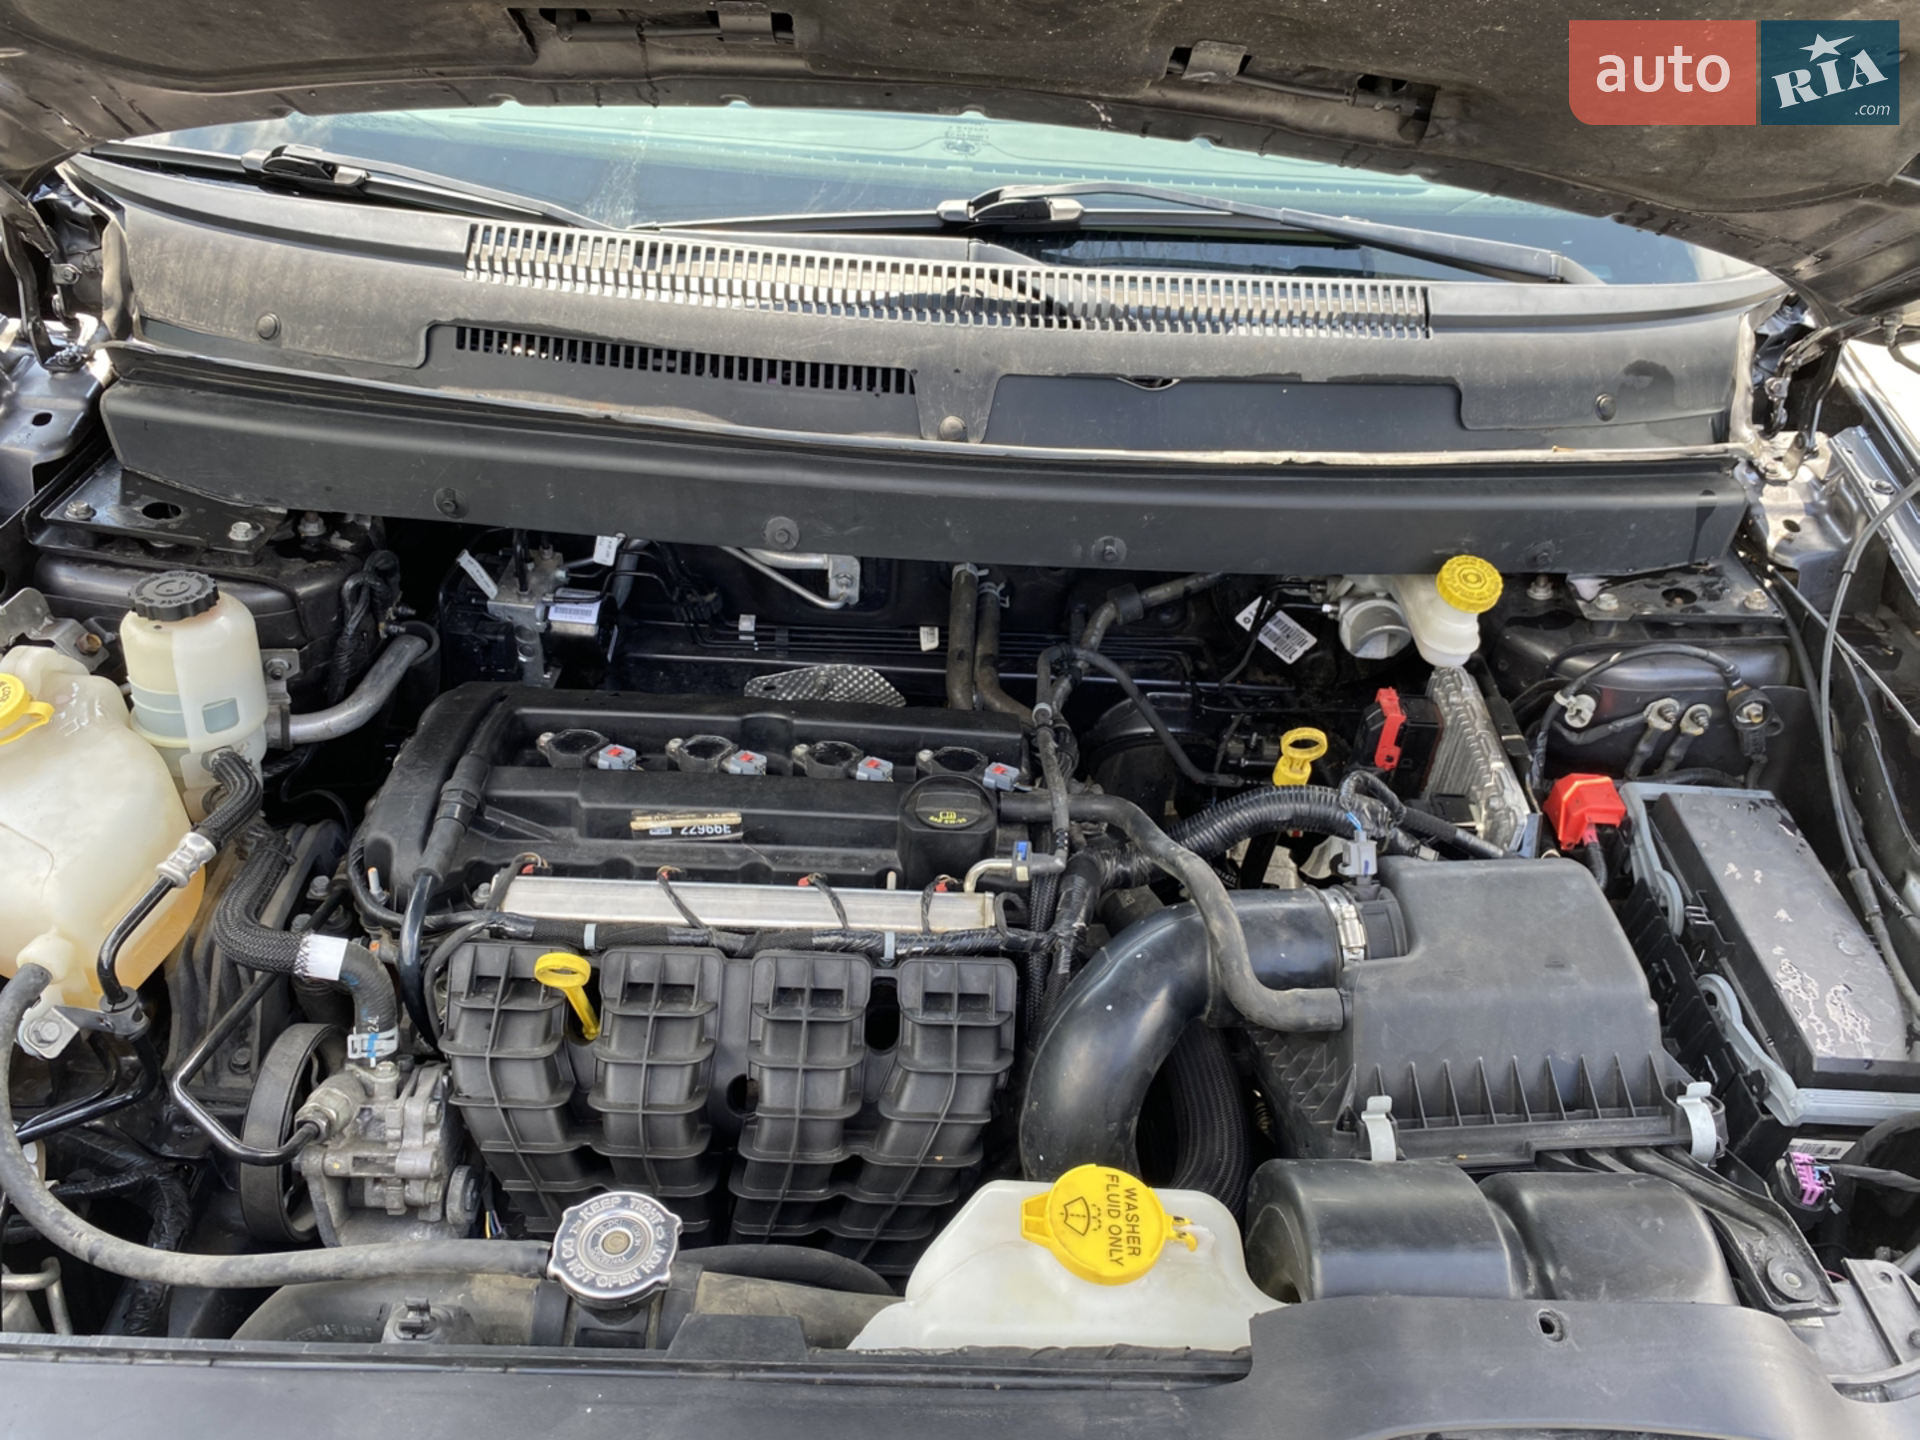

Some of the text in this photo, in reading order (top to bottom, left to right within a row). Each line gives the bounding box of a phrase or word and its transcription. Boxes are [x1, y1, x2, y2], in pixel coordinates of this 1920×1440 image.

[579, 1196, 666, 1224] KEEP TIGHT
[1105, 1173, 1125, 1268] FLUID ONLY
[1124, 1187, 1142, 1257] WASHER
[561, 1238, 575, 1259] DO
[640, 1244, 667, 1274] HOT
[565, 1258, 596, 1283] NOT
[595, 1269, 642, 1288] OPEN
